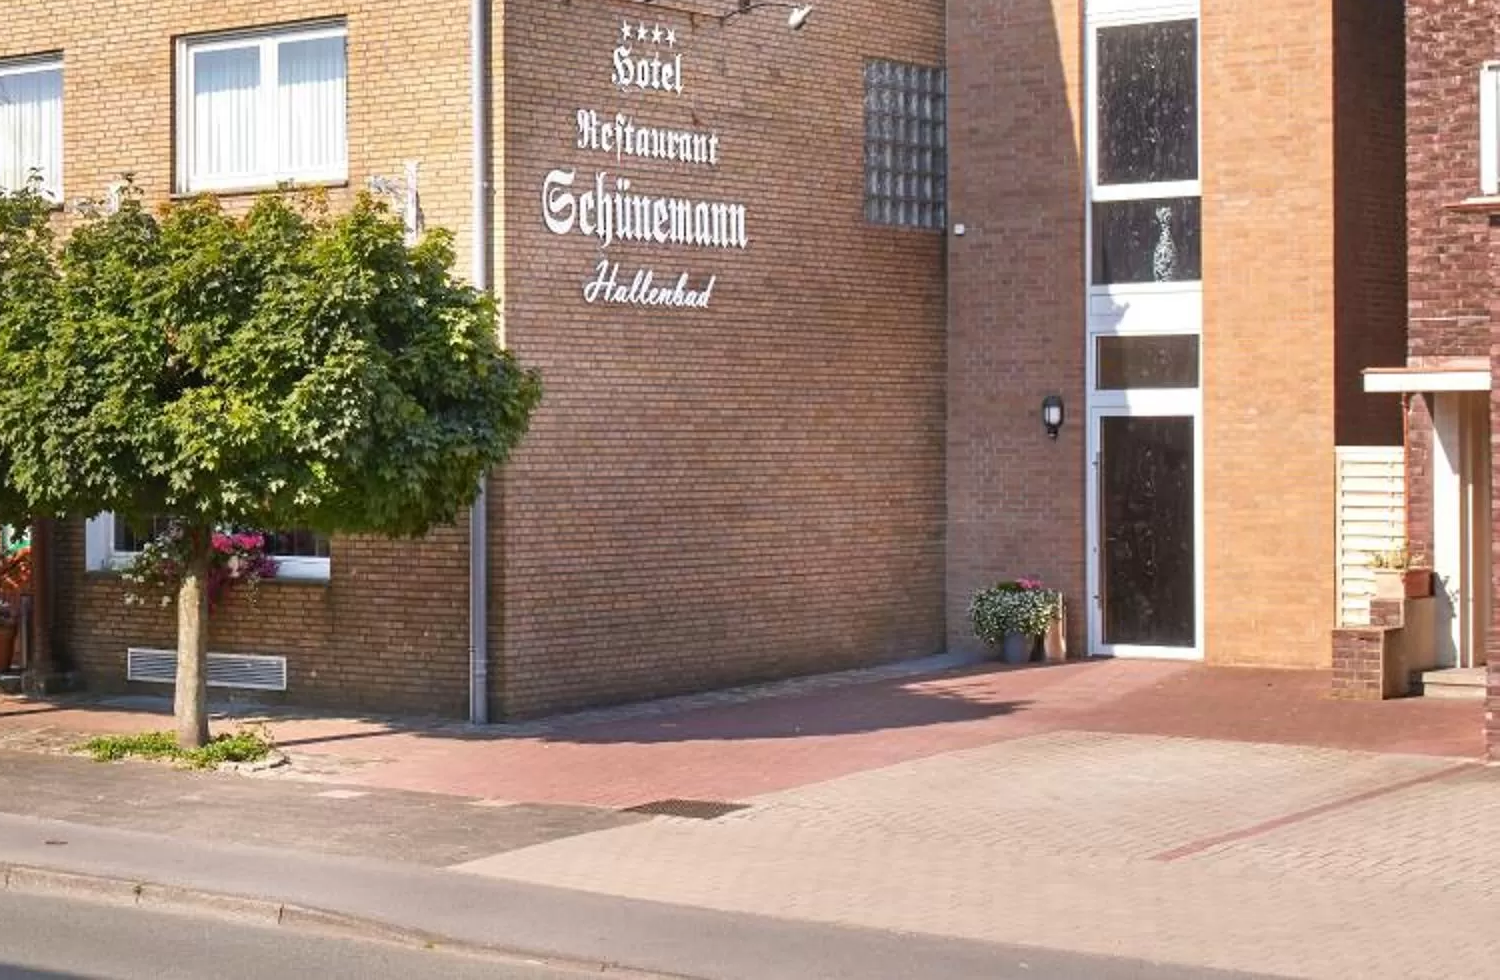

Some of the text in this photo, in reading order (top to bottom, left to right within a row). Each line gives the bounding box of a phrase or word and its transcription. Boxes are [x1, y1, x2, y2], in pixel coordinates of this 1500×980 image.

[612, 45, 684, 96] Hotel
[543, 169, 748, 249] Schünemann
[584, 259, 716, 308] Hallenbad
